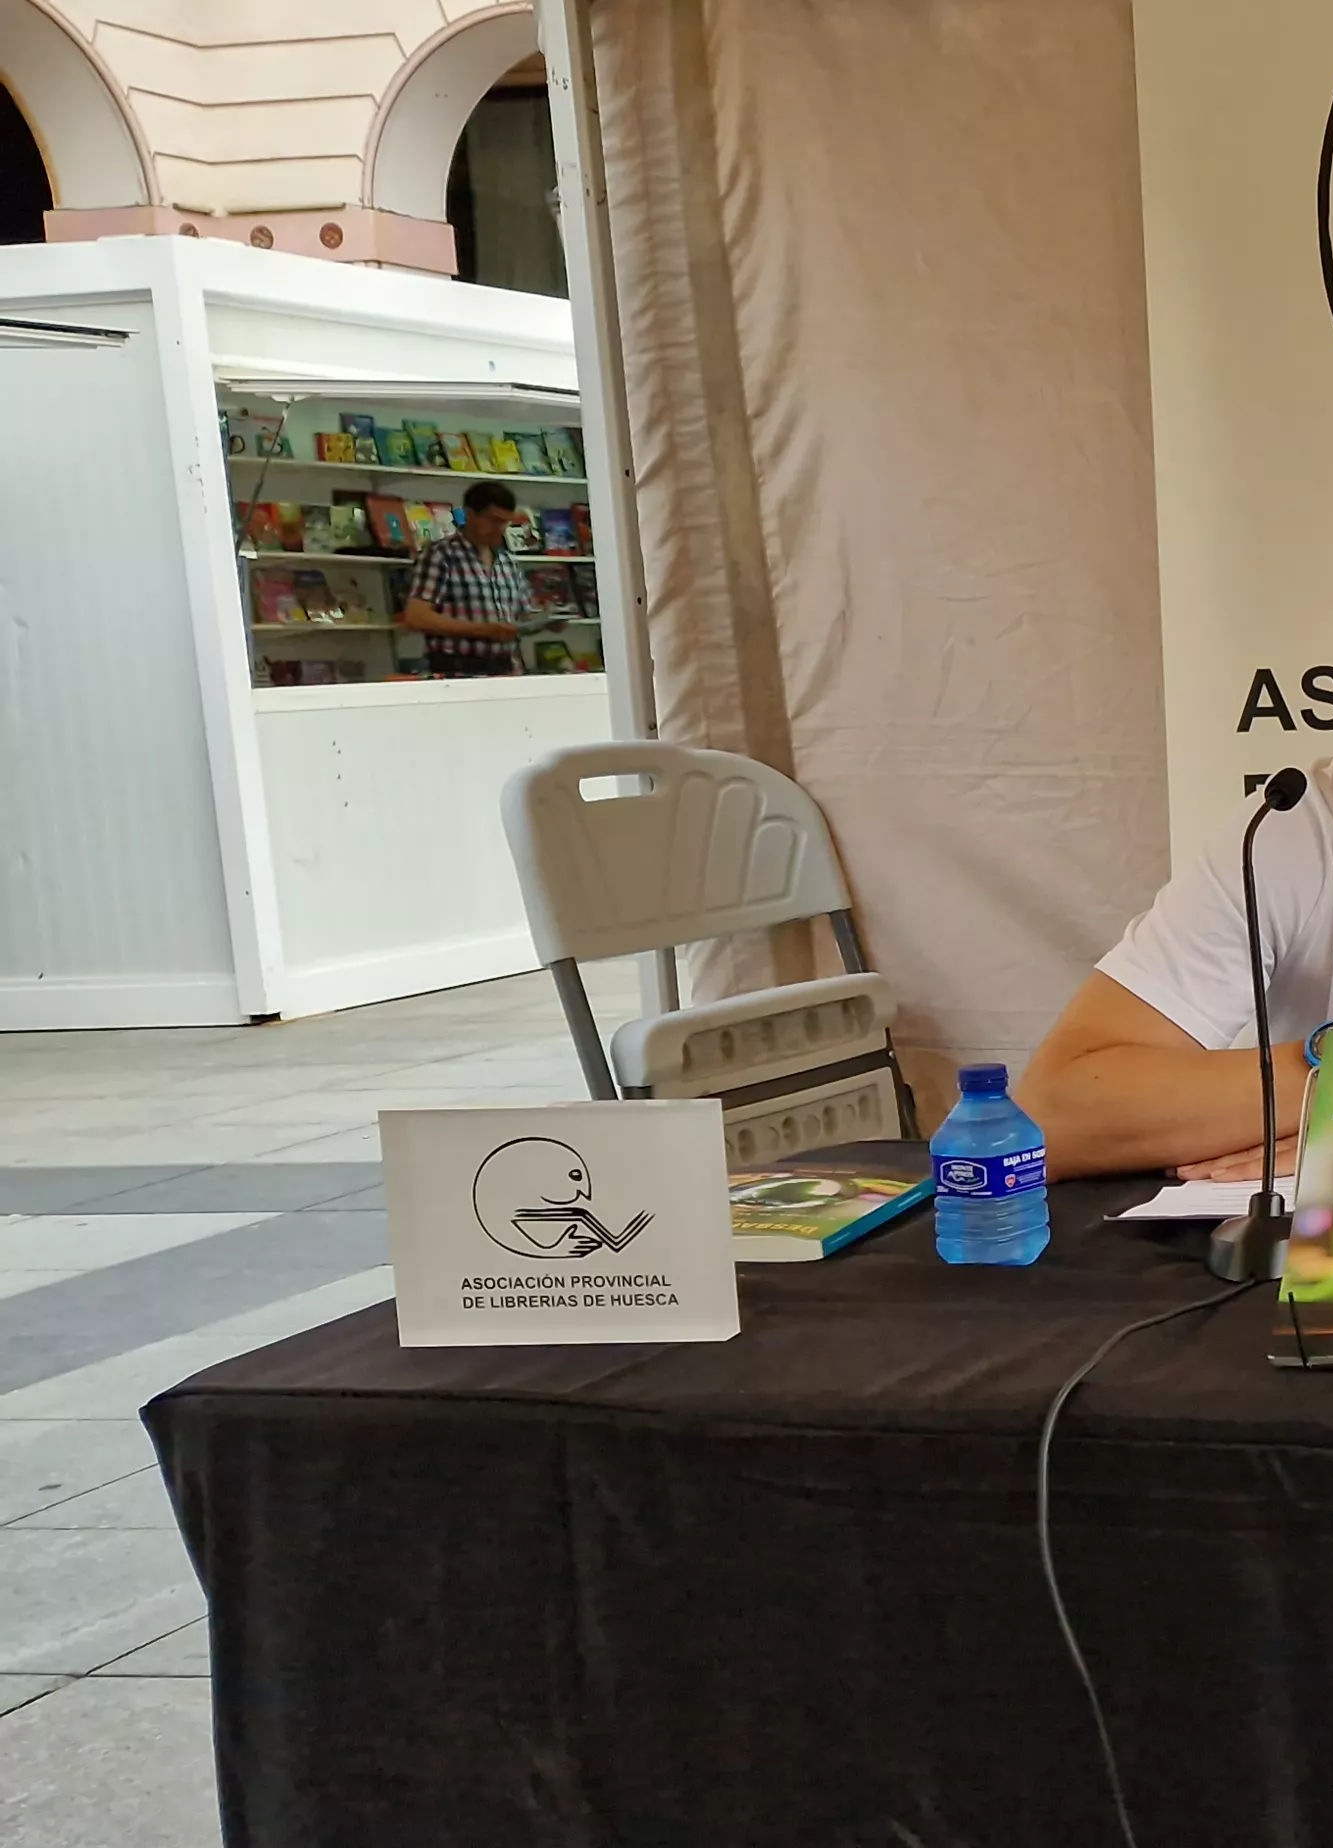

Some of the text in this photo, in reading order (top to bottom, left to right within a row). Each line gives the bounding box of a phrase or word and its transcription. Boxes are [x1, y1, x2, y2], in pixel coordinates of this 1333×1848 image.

[461, 1273, 672, 1290] ASOCIACIÓN PROVINCIAL
[463, 1293, 679, 1309] DE LIBRERIAS DE HUESCA
